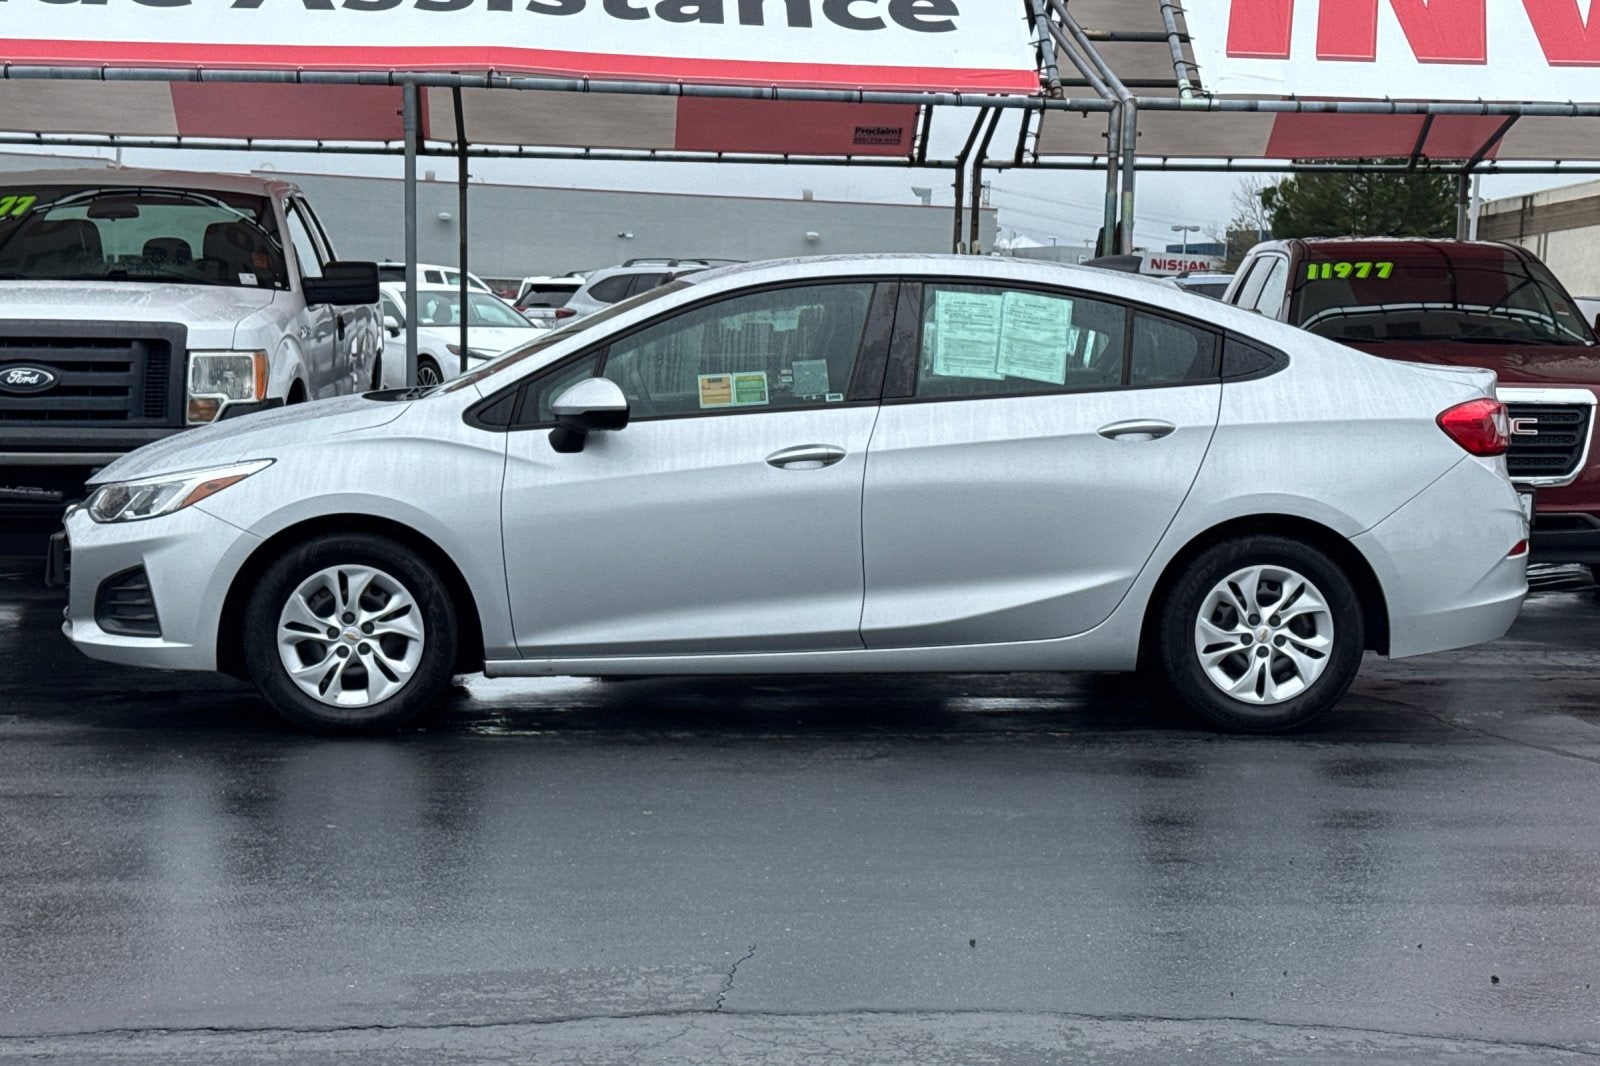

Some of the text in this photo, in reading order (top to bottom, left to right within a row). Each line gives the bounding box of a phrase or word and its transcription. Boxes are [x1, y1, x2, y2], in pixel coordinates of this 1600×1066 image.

[854, 127, 902, 137] Proclaim!
[1151, 258, 1210, 272] NISSAN
[1307, 261, 1394, 280] 11977
[7, 370, 40, 384] Ford
